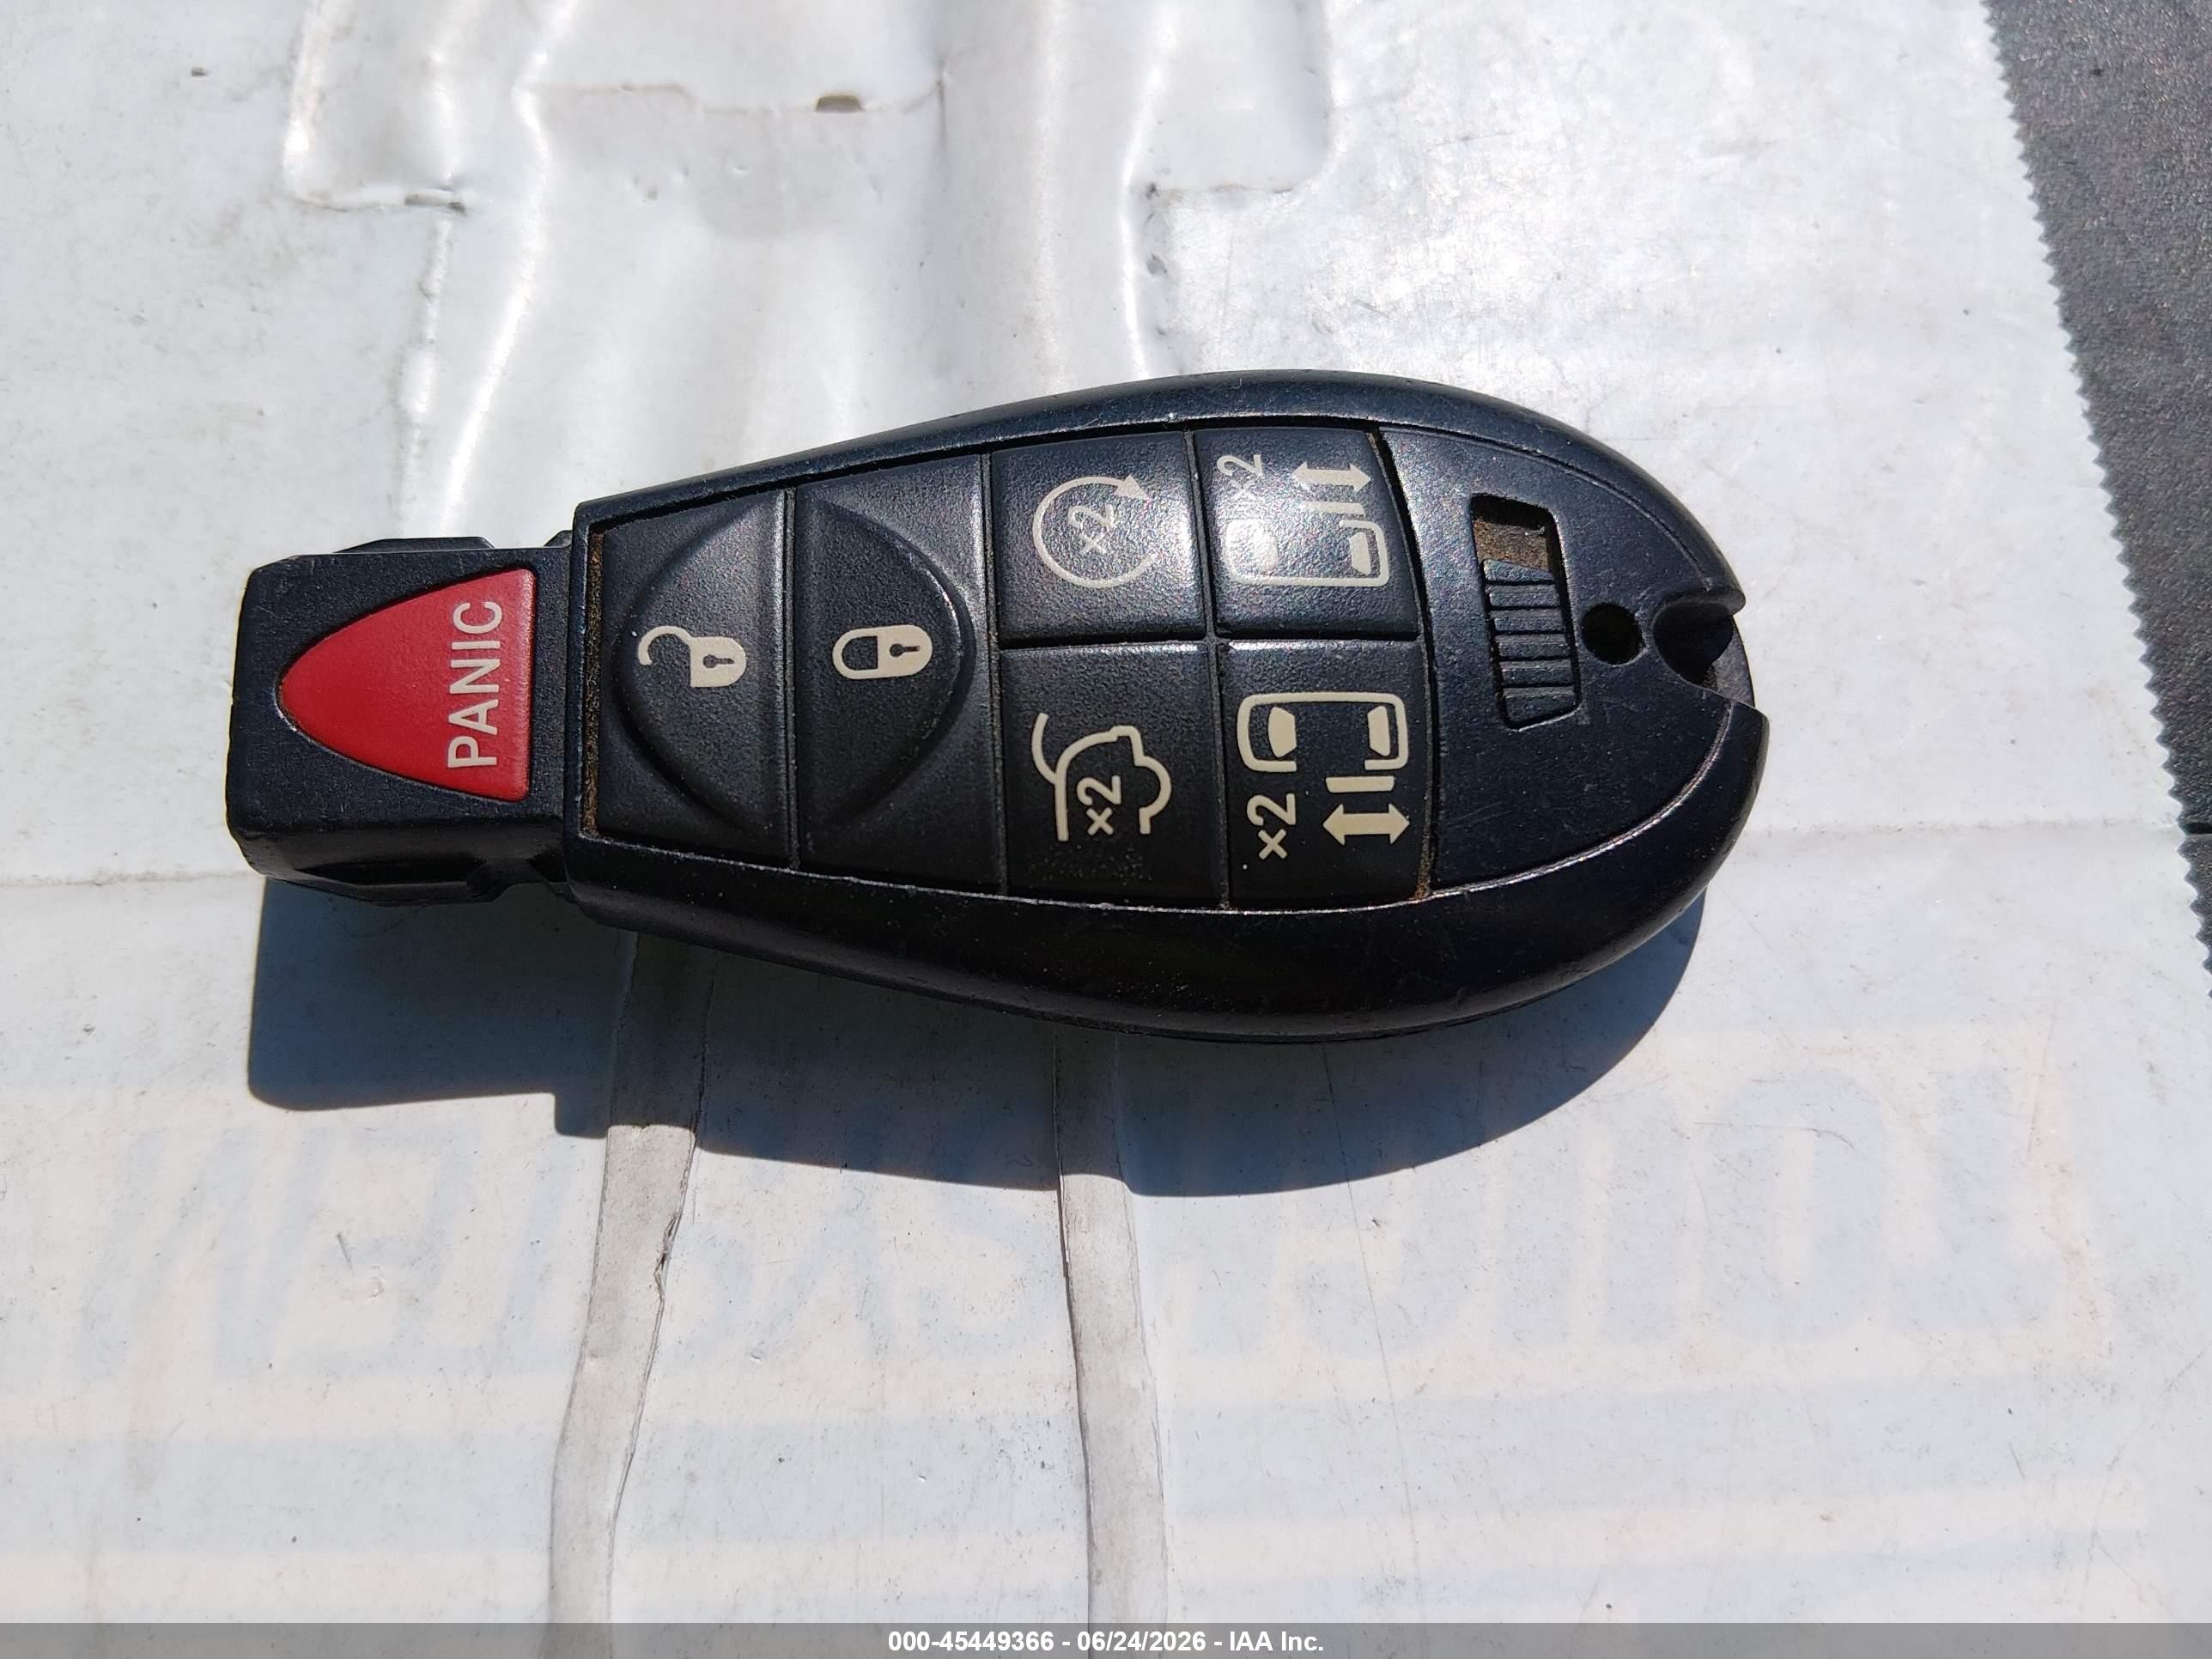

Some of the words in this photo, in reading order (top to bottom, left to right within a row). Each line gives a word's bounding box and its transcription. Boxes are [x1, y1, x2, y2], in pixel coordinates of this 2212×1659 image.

[447, 601, 502, 768] PANIC
[1076, 775, 1121, 836] x2
[1246, 793, 1297, 860] x2
